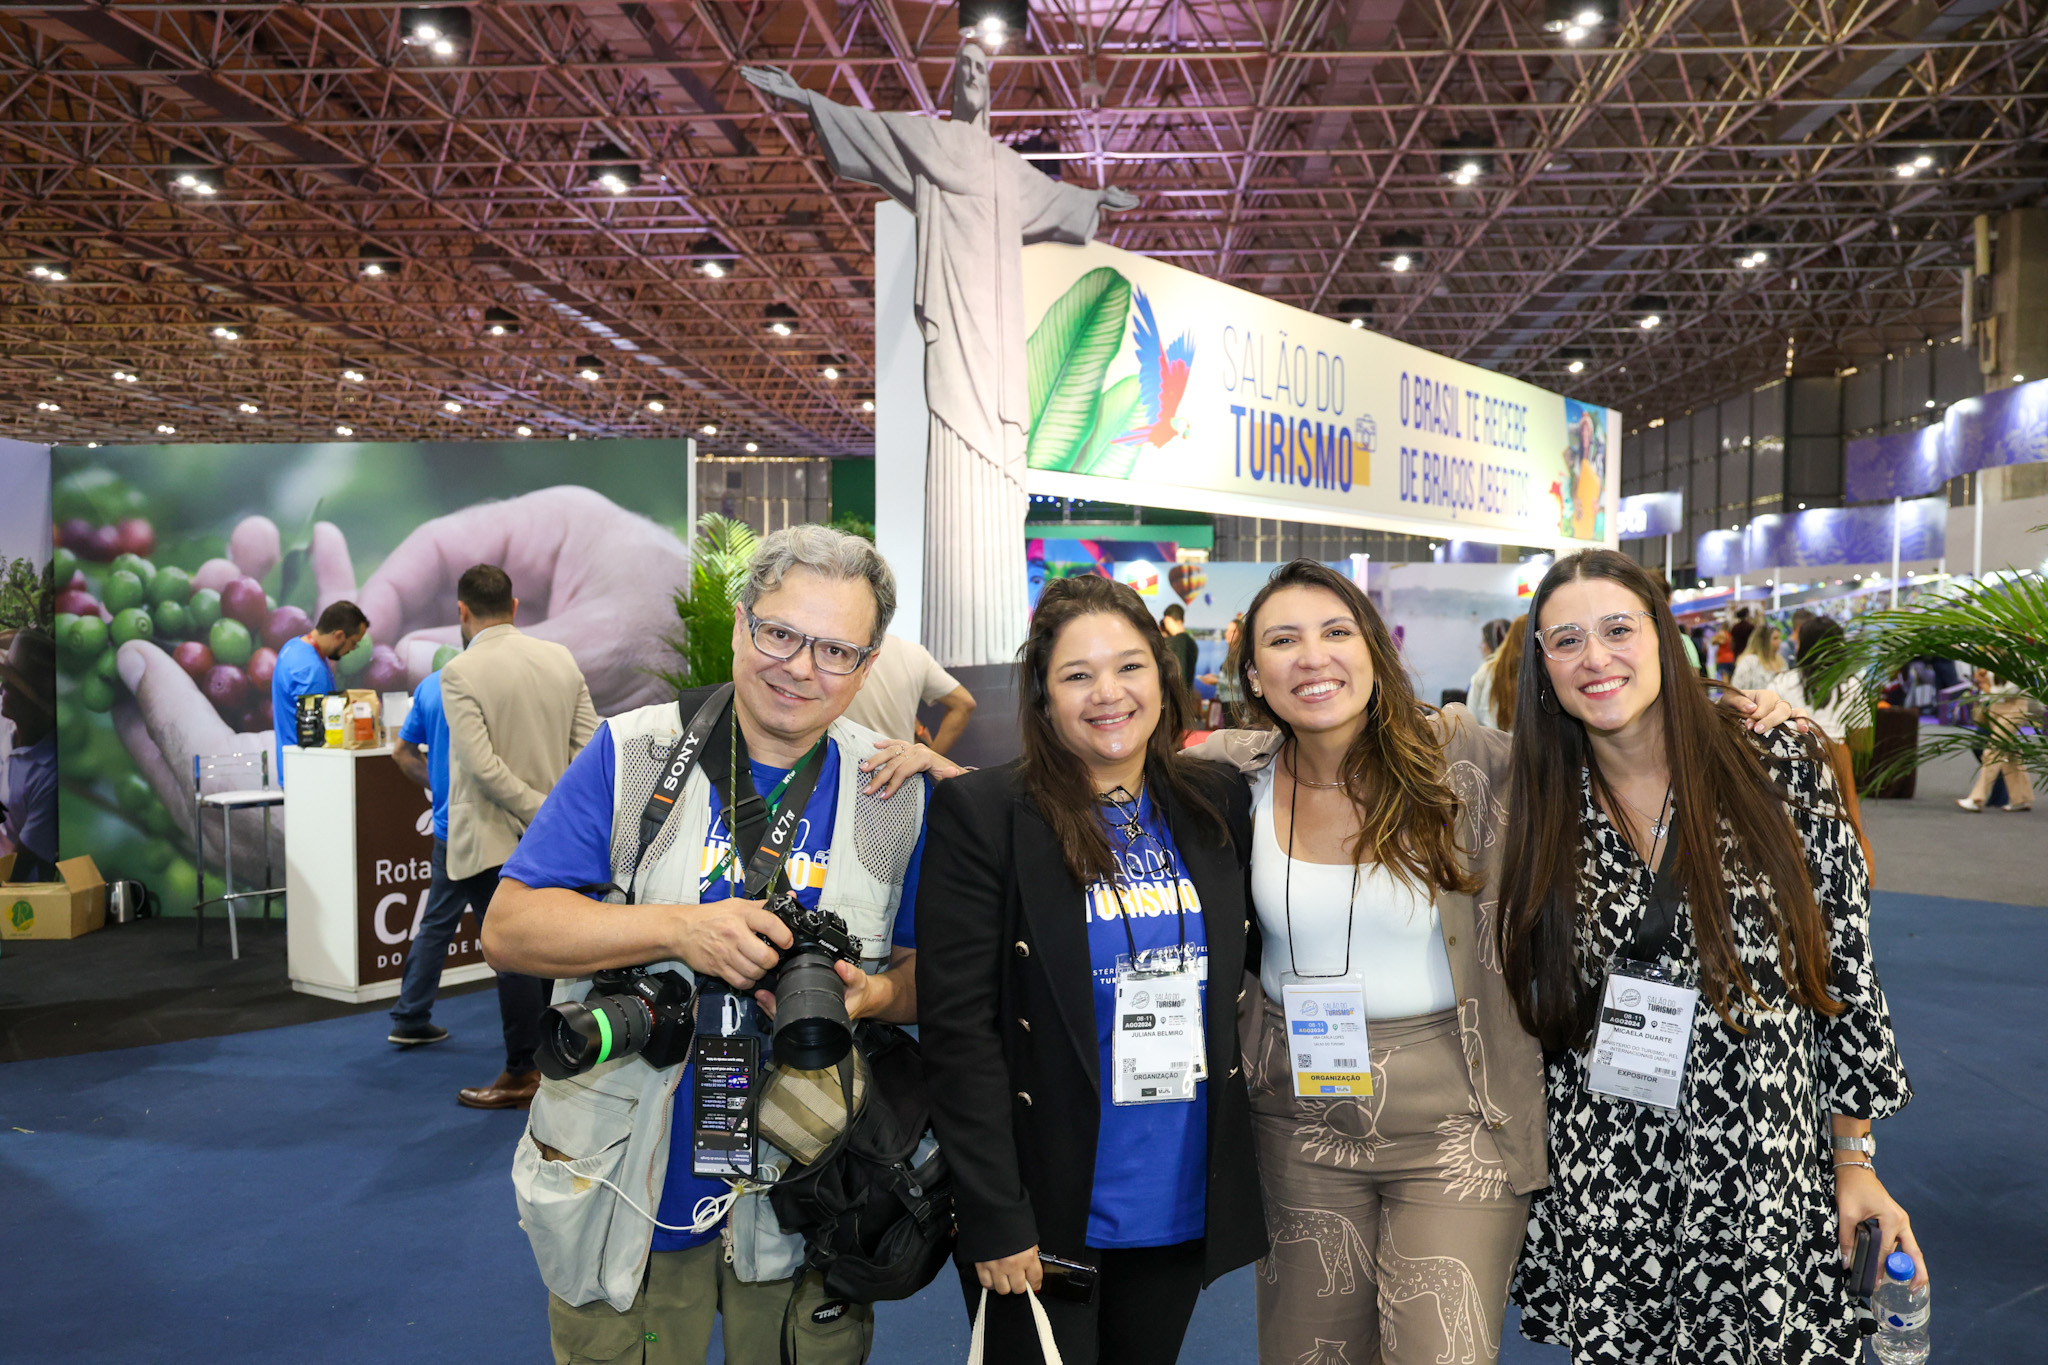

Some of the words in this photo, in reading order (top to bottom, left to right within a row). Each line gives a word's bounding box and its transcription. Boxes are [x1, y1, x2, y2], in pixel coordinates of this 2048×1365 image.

[1223, 325, 1308, 408] SALÃO
[1317, 350, 1345, 416] DO
[1400, 371, 1409, 427] O
[1414, 375, 1461, 438] BRASIL
[1466, 390, 1480, 442] TE
[1484, 395, 1528, 453] RECEBE
[1230, 404, 1353, 493] TURISMO
[1400, 446, 1419, 502] DE
[1423, 450, 1475, 518] BRAÇOS
[1477, 463, 1529, 517] ABERTOS
[663, 732, 700, 791] SONY
[375, 857, 432, 886] Rota
[1085, 878, 1202, 923] TURISMO
[377, 952, 403, 968] DO
[639, 982, 655, 997] SONY
[1156, 1000, 1181, 1009] TURISMO
[1647, 1003, 1678, 1016] TURISMO
[1609, 1017, 1641, 1027] AGO2024
[1614, 1027, 1643, 1038] MICAELA
[1645, 1033, 1673, 1044] DUARTE
[1133, 1072, 1178, 1081] ORGANIZAÇÃO
[1310, 1074, 1361, 1082] ORGANIZAÇÃO
[1617, 1070, 1658, 1083] EXPOSITOR
